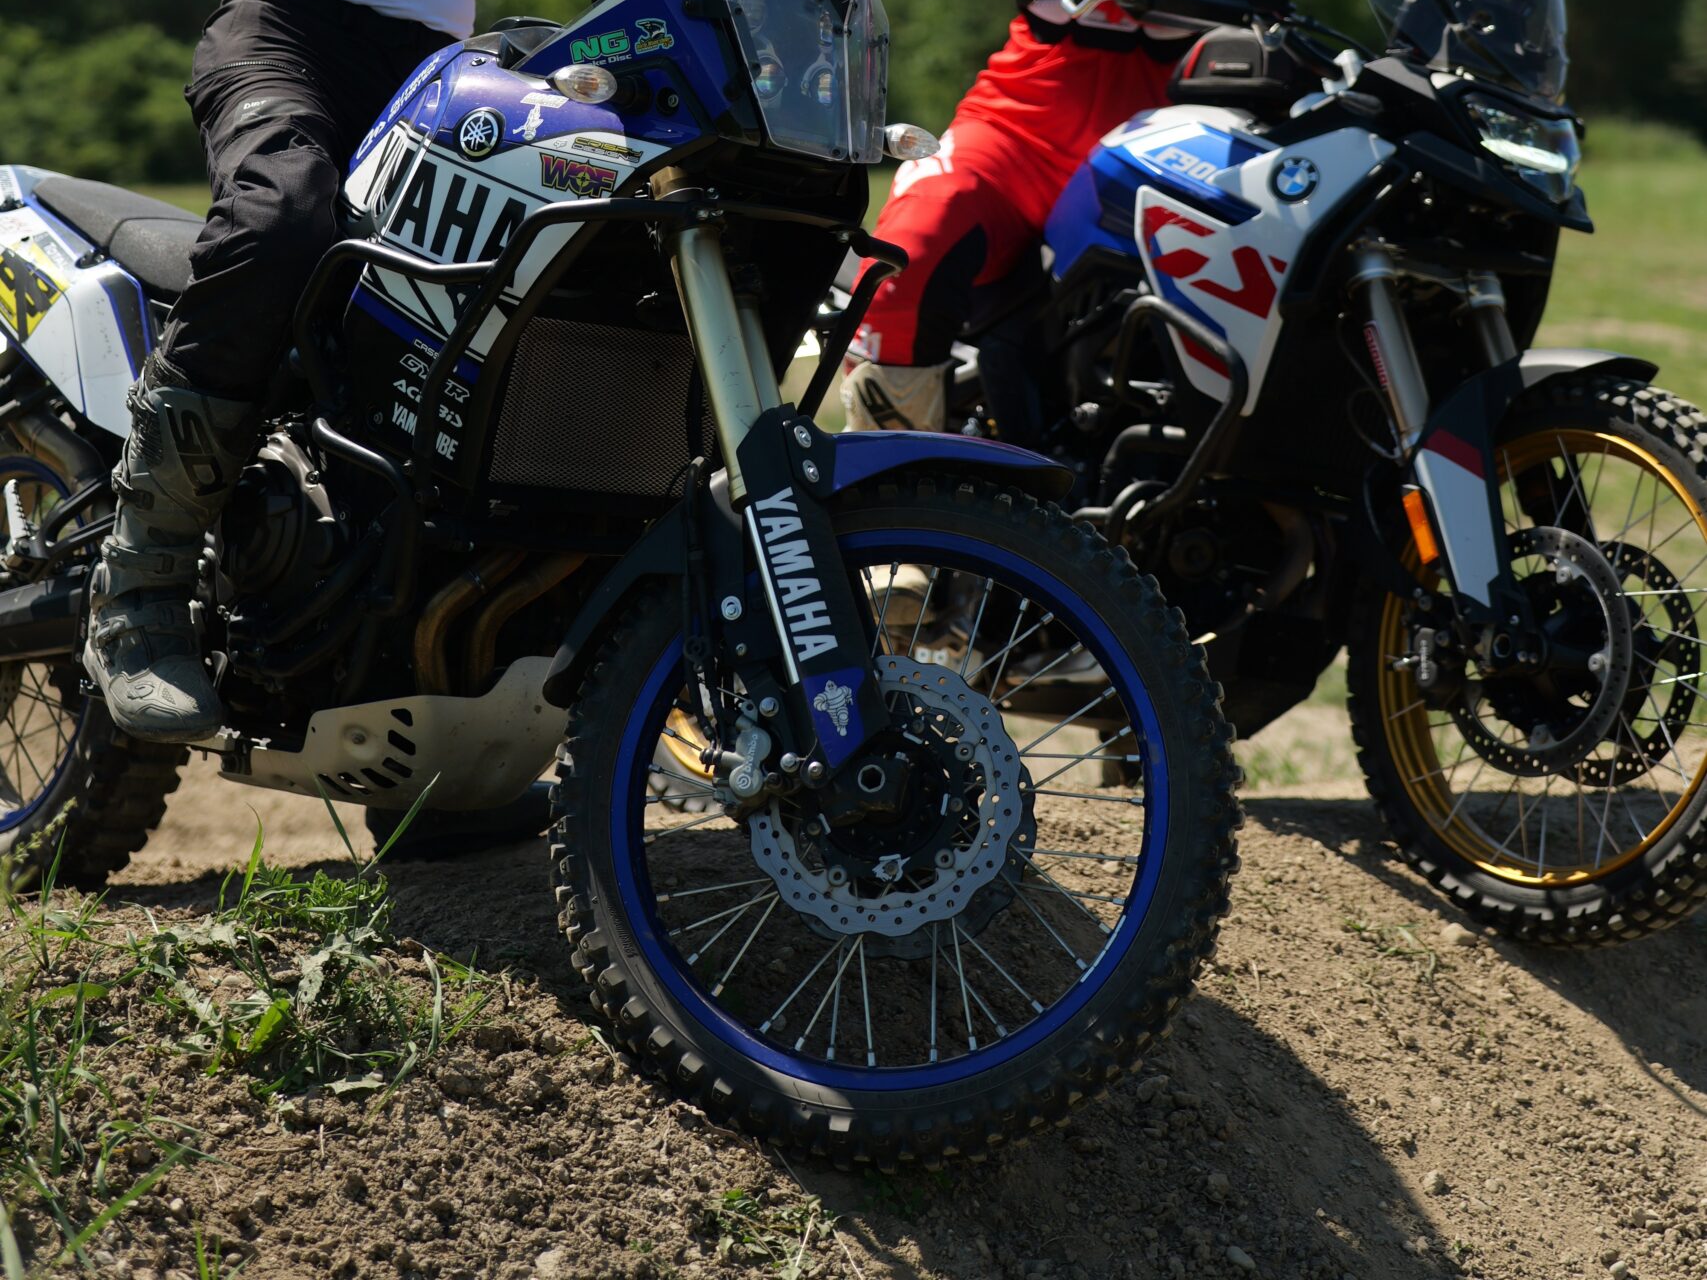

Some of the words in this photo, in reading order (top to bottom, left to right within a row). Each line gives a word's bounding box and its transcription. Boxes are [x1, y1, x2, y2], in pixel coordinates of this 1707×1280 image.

[570, 29, 630, 64] NG
[608, 53, 632, 64] Disc
[539, 152, 618, 199] WOF
[755, 486, 839, 662] YAMAHA
[744, 733, 759, 773] brembo
